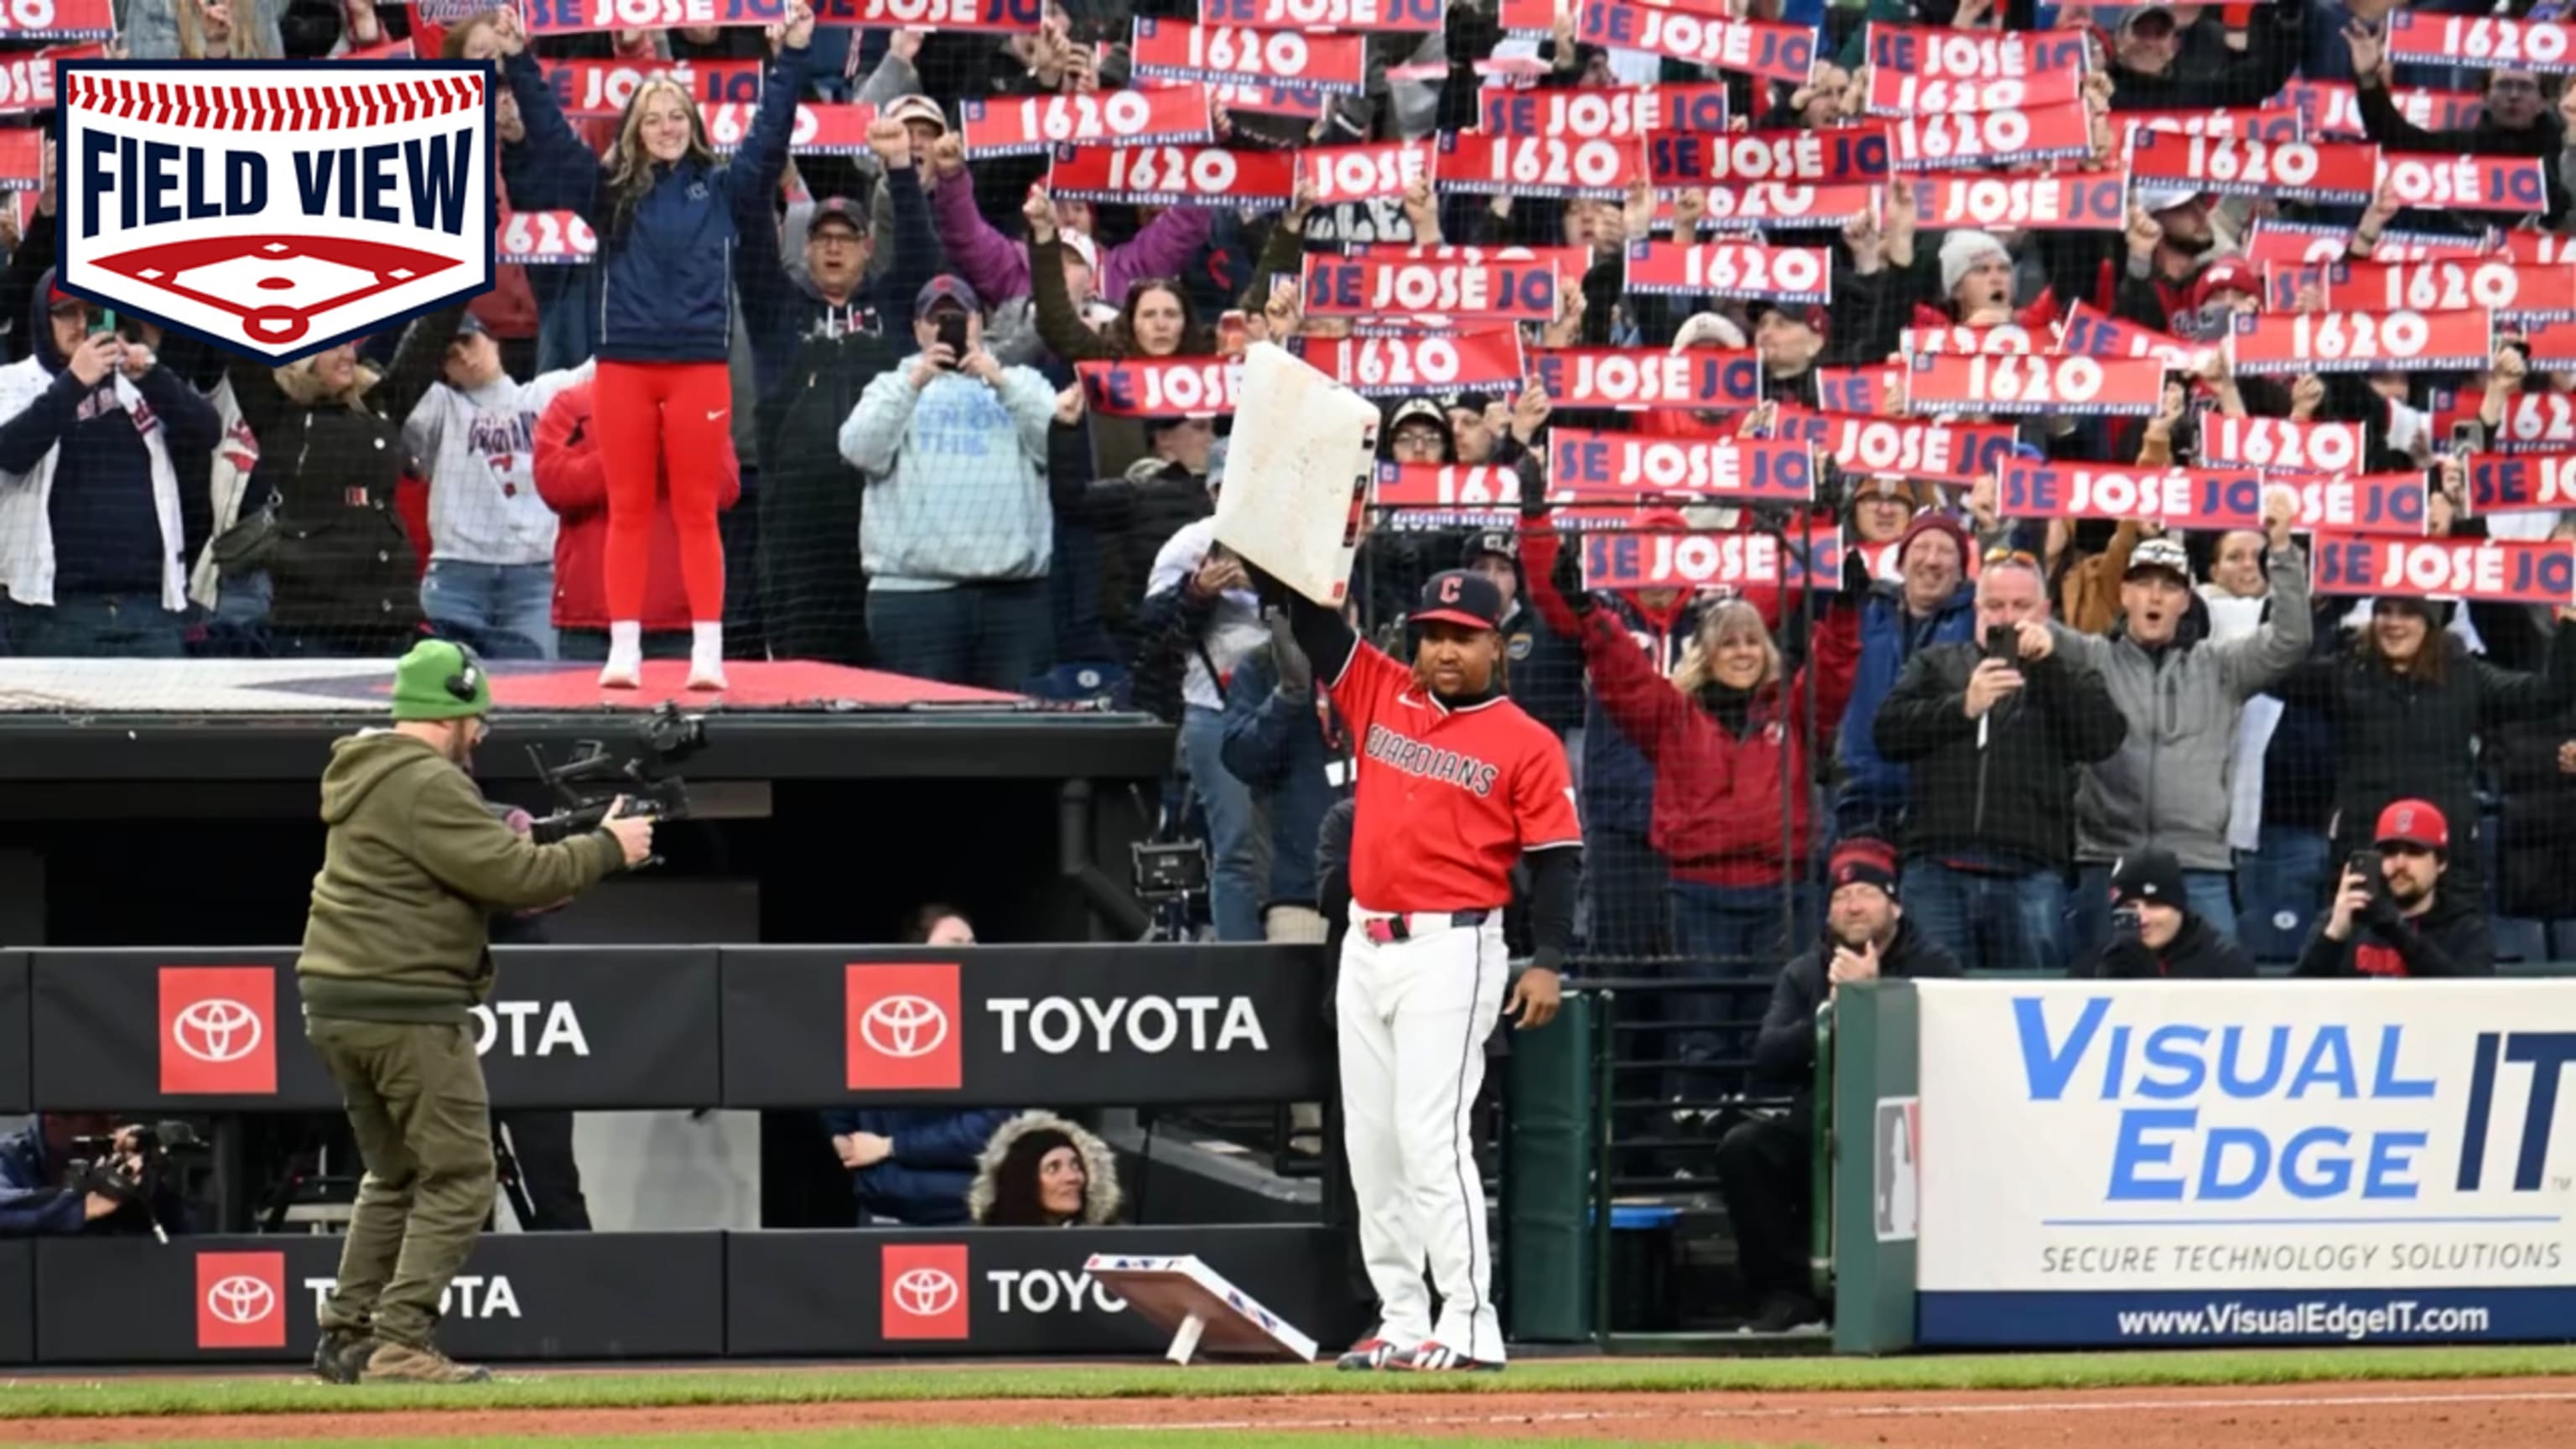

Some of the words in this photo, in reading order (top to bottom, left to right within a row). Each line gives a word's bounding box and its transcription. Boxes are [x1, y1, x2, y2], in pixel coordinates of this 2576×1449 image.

[1189, 25, 1308, 75] 1620
[1757, 33, 1810, 73] JO
[1924, 31, 2025, 77] JOSÉ
[2443, 16, 2568, 61] 1620
[1021, 91, 1150, 141] 1620
[1546, 86, 1659, 137] JOSÉ
[1673, 94, 1723, 132] JO
[1711, 130, 1823, 178] JOSÉ
[1835, 136, 1888, 174] JO
[1899, 111, 2029, 161] 1620
[2188, 134, 2318, 185] 1620
[1108, 147, 1237, 193] 1620
[1492, 136, 1618, 186] 1620
[1944, 171, 2059, 222] JOSÉ
[2067, 181, 2122, 220] JO
[2490, 169, 2541, 203] JO
[505, 213, 598, 254] 620
[1497, 269, 1553, 310] JO
[1685, 247, 1819, 291] 1620
[2386, 262, 2518, 309] 1620
[2293, 311, 2429, 359] 1620
[1337, 336, 1459, 384] 1620
[1701, 358, 1757, 401] JO
[1969, 354, 2103, 402] 1620
[1619, 436, 1741, 488] JOSÉ
[1750, 450, 1810, 489] JO
[2224, 418, 2354, 470] 1620
[1438, 465, 1520, 514] 162
[2068, 466, 2192, 514] JOSÉ
[2202, 477, 2259, 514] JO
[2365, 485, 2423, 524] JO
[2382, 538, 2504, 592] JOSÉ
[2513, 550, 2573, 594] JO
[1440, 577, 1463, 604] C
[1365, 724, 1498, 797] GUARDIANS
[986, 996, 1269, 1053] TOYOTA
[2012, 996, 2437, 1100] VISUAL
[2104, 1108, 2428, 1202] EDGE
[2455, 1031, 2576, 1192] IT
[2041, 1246, 2158, 1274] SECURE
[2174, 1244, 2378, 1271] TECHNOLOGY
[2389, 1242, 2562, 1270] SOLUTIONS
[987, 1270, 1127, 1313] TOYO
[2118, 1301, 2489, 1340] www.VisualEdgeIT.com
